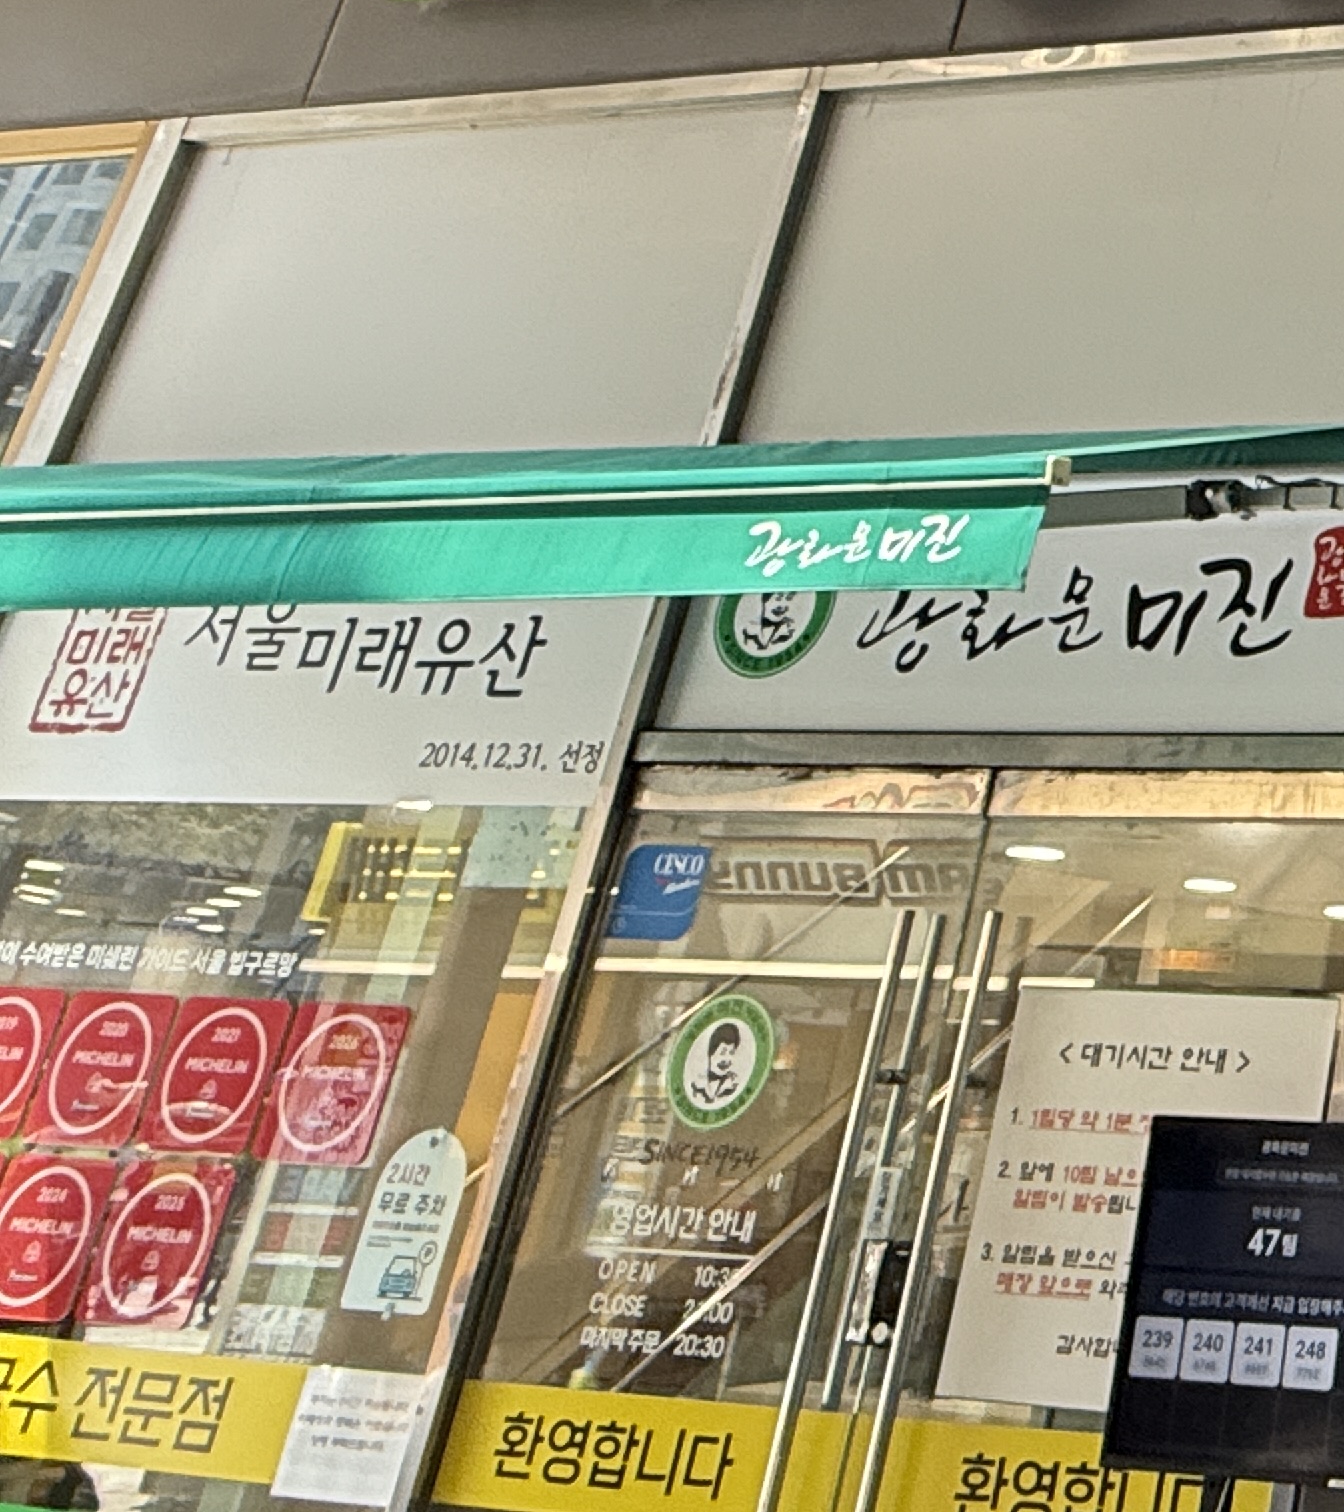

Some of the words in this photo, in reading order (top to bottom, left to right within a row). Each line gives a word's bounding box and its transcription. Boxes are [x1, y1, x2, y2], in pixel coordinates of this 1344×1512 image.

[66, 626, 151, 666] 미래
[49, 668, 131, 719] 유산
[1081, 1043, 1173, 1070] 대기시간
[1180, 1047, 1229, 1074] 안내
[9, 1217, 75, 1234] MICHELIN
[610, 1200, 703, 1239] 영업시간
[707, 1208, 758, 1244] 안내
[127, 1227, 194, 1243] MICHELIN
[598, 1259, 657, 1283] OPEN
[589, 1292, 648, 1317] CLOSE
[673, 1334, 726, 1359] 20:30
[1142, 1329, 1174, 1349] 239
[1192, 1333, 1225, 1352] 240
[1244, 1336, 1274, 1356] 241
[1295, 1340, 1327, 1360] 248
[71, 1366, 236, 1455] 전문점
[493, 1411, 736, 1501] 환영합니다
